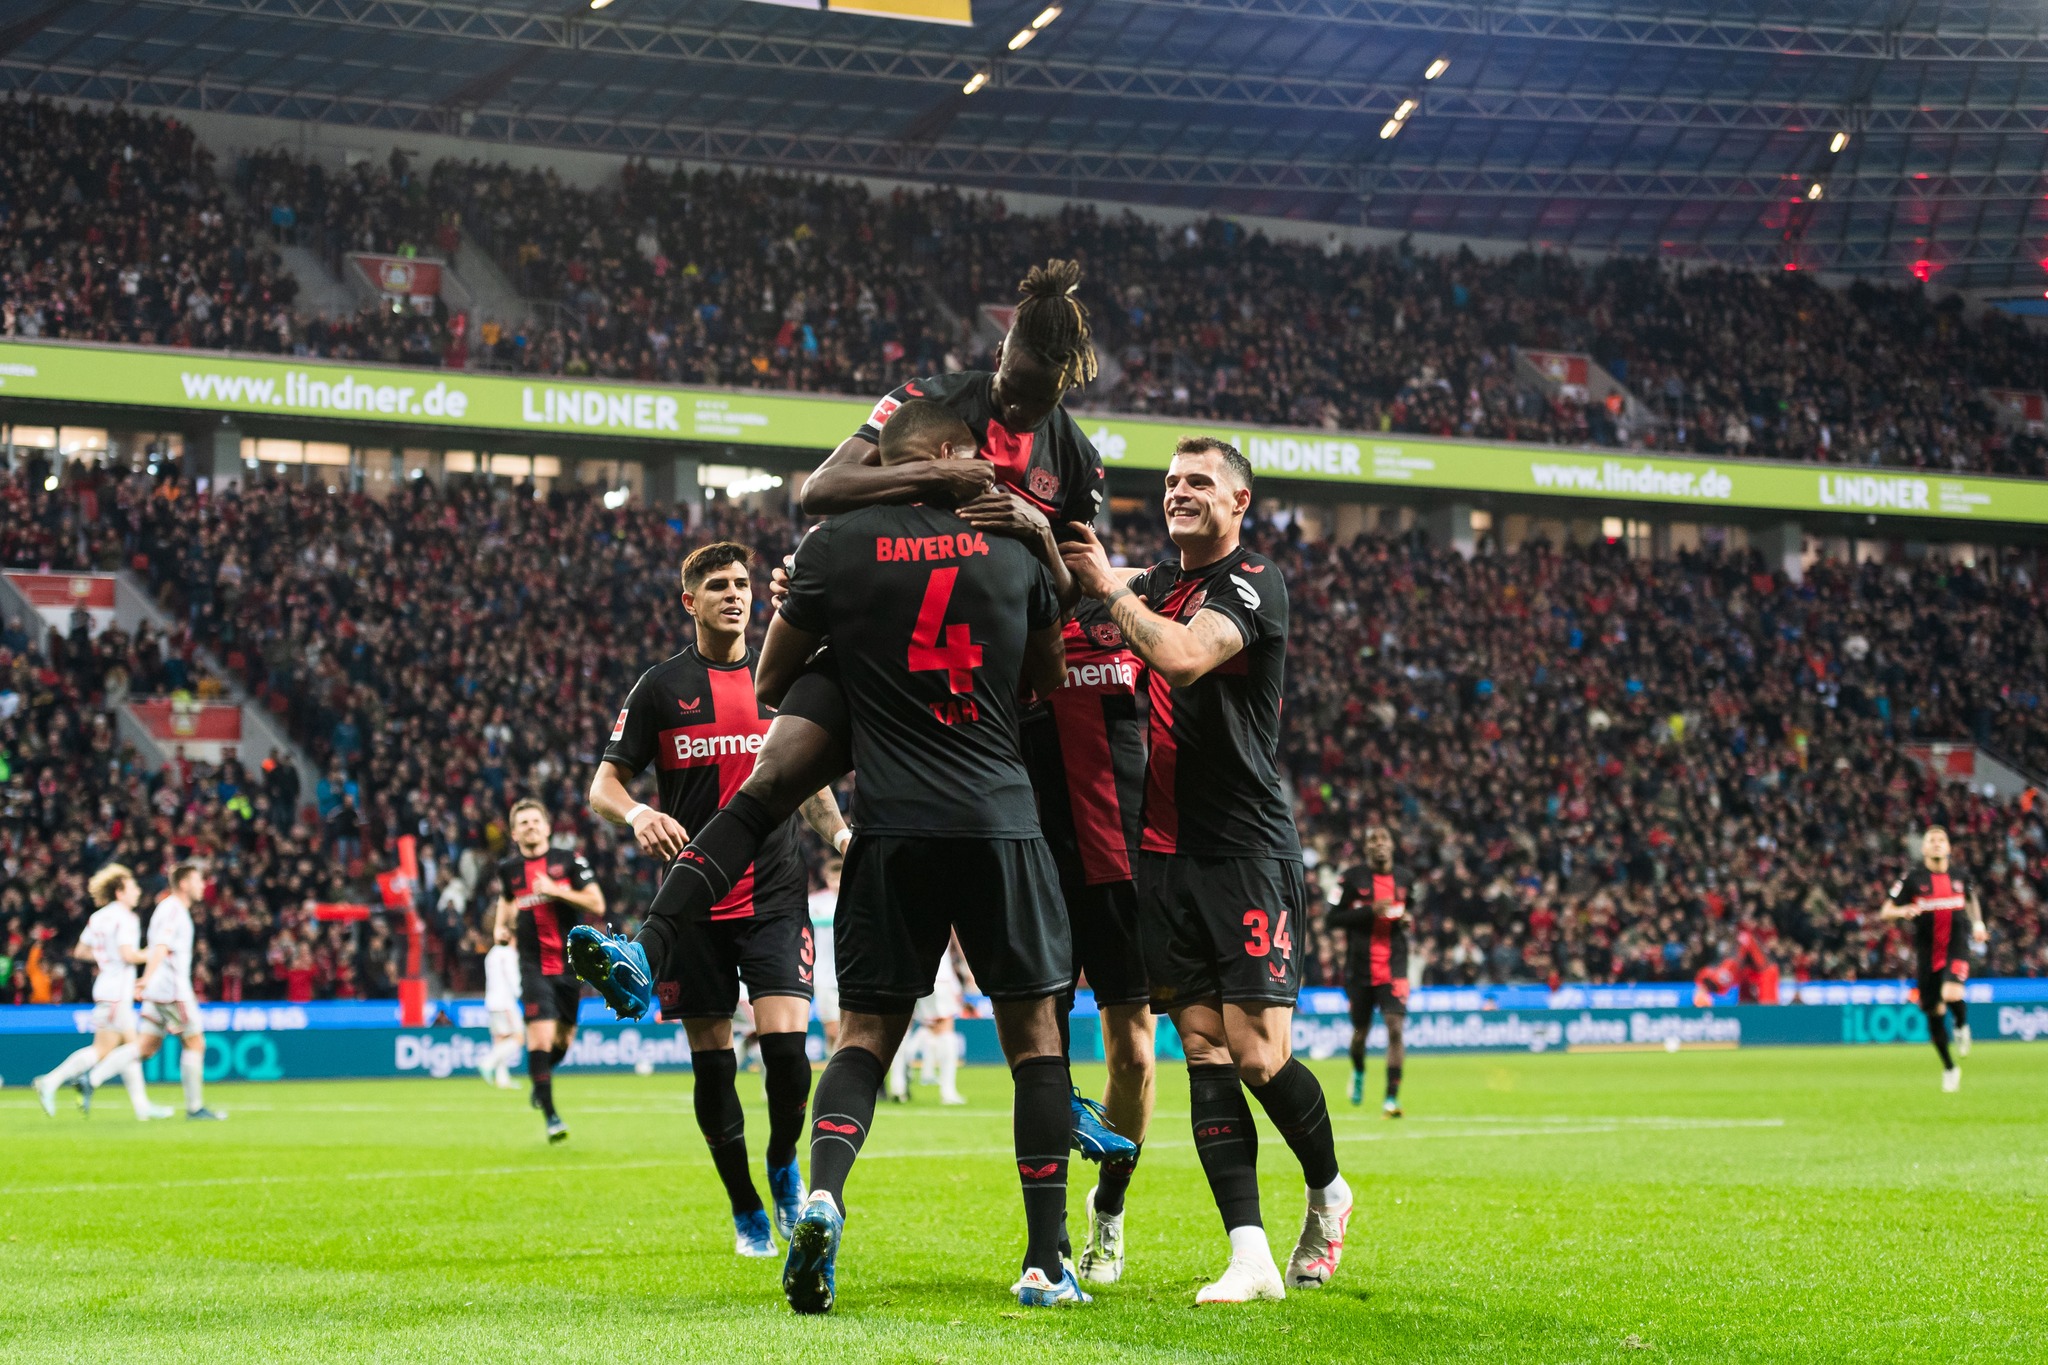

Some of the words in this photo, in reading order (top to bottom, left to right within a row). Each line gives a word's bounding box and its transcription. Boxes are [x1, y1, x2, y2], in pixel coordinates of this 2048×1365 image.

[180, 371, 468, 418] www.lindner.de
[1531, 461, 1732, 498] www.lindner.de
[876, 536, 956, 562] BAYER
[907, 566, 983, 694] 4
[673, 732, 769, 760] Barme
[1242, 909, 1292, 960] 34
